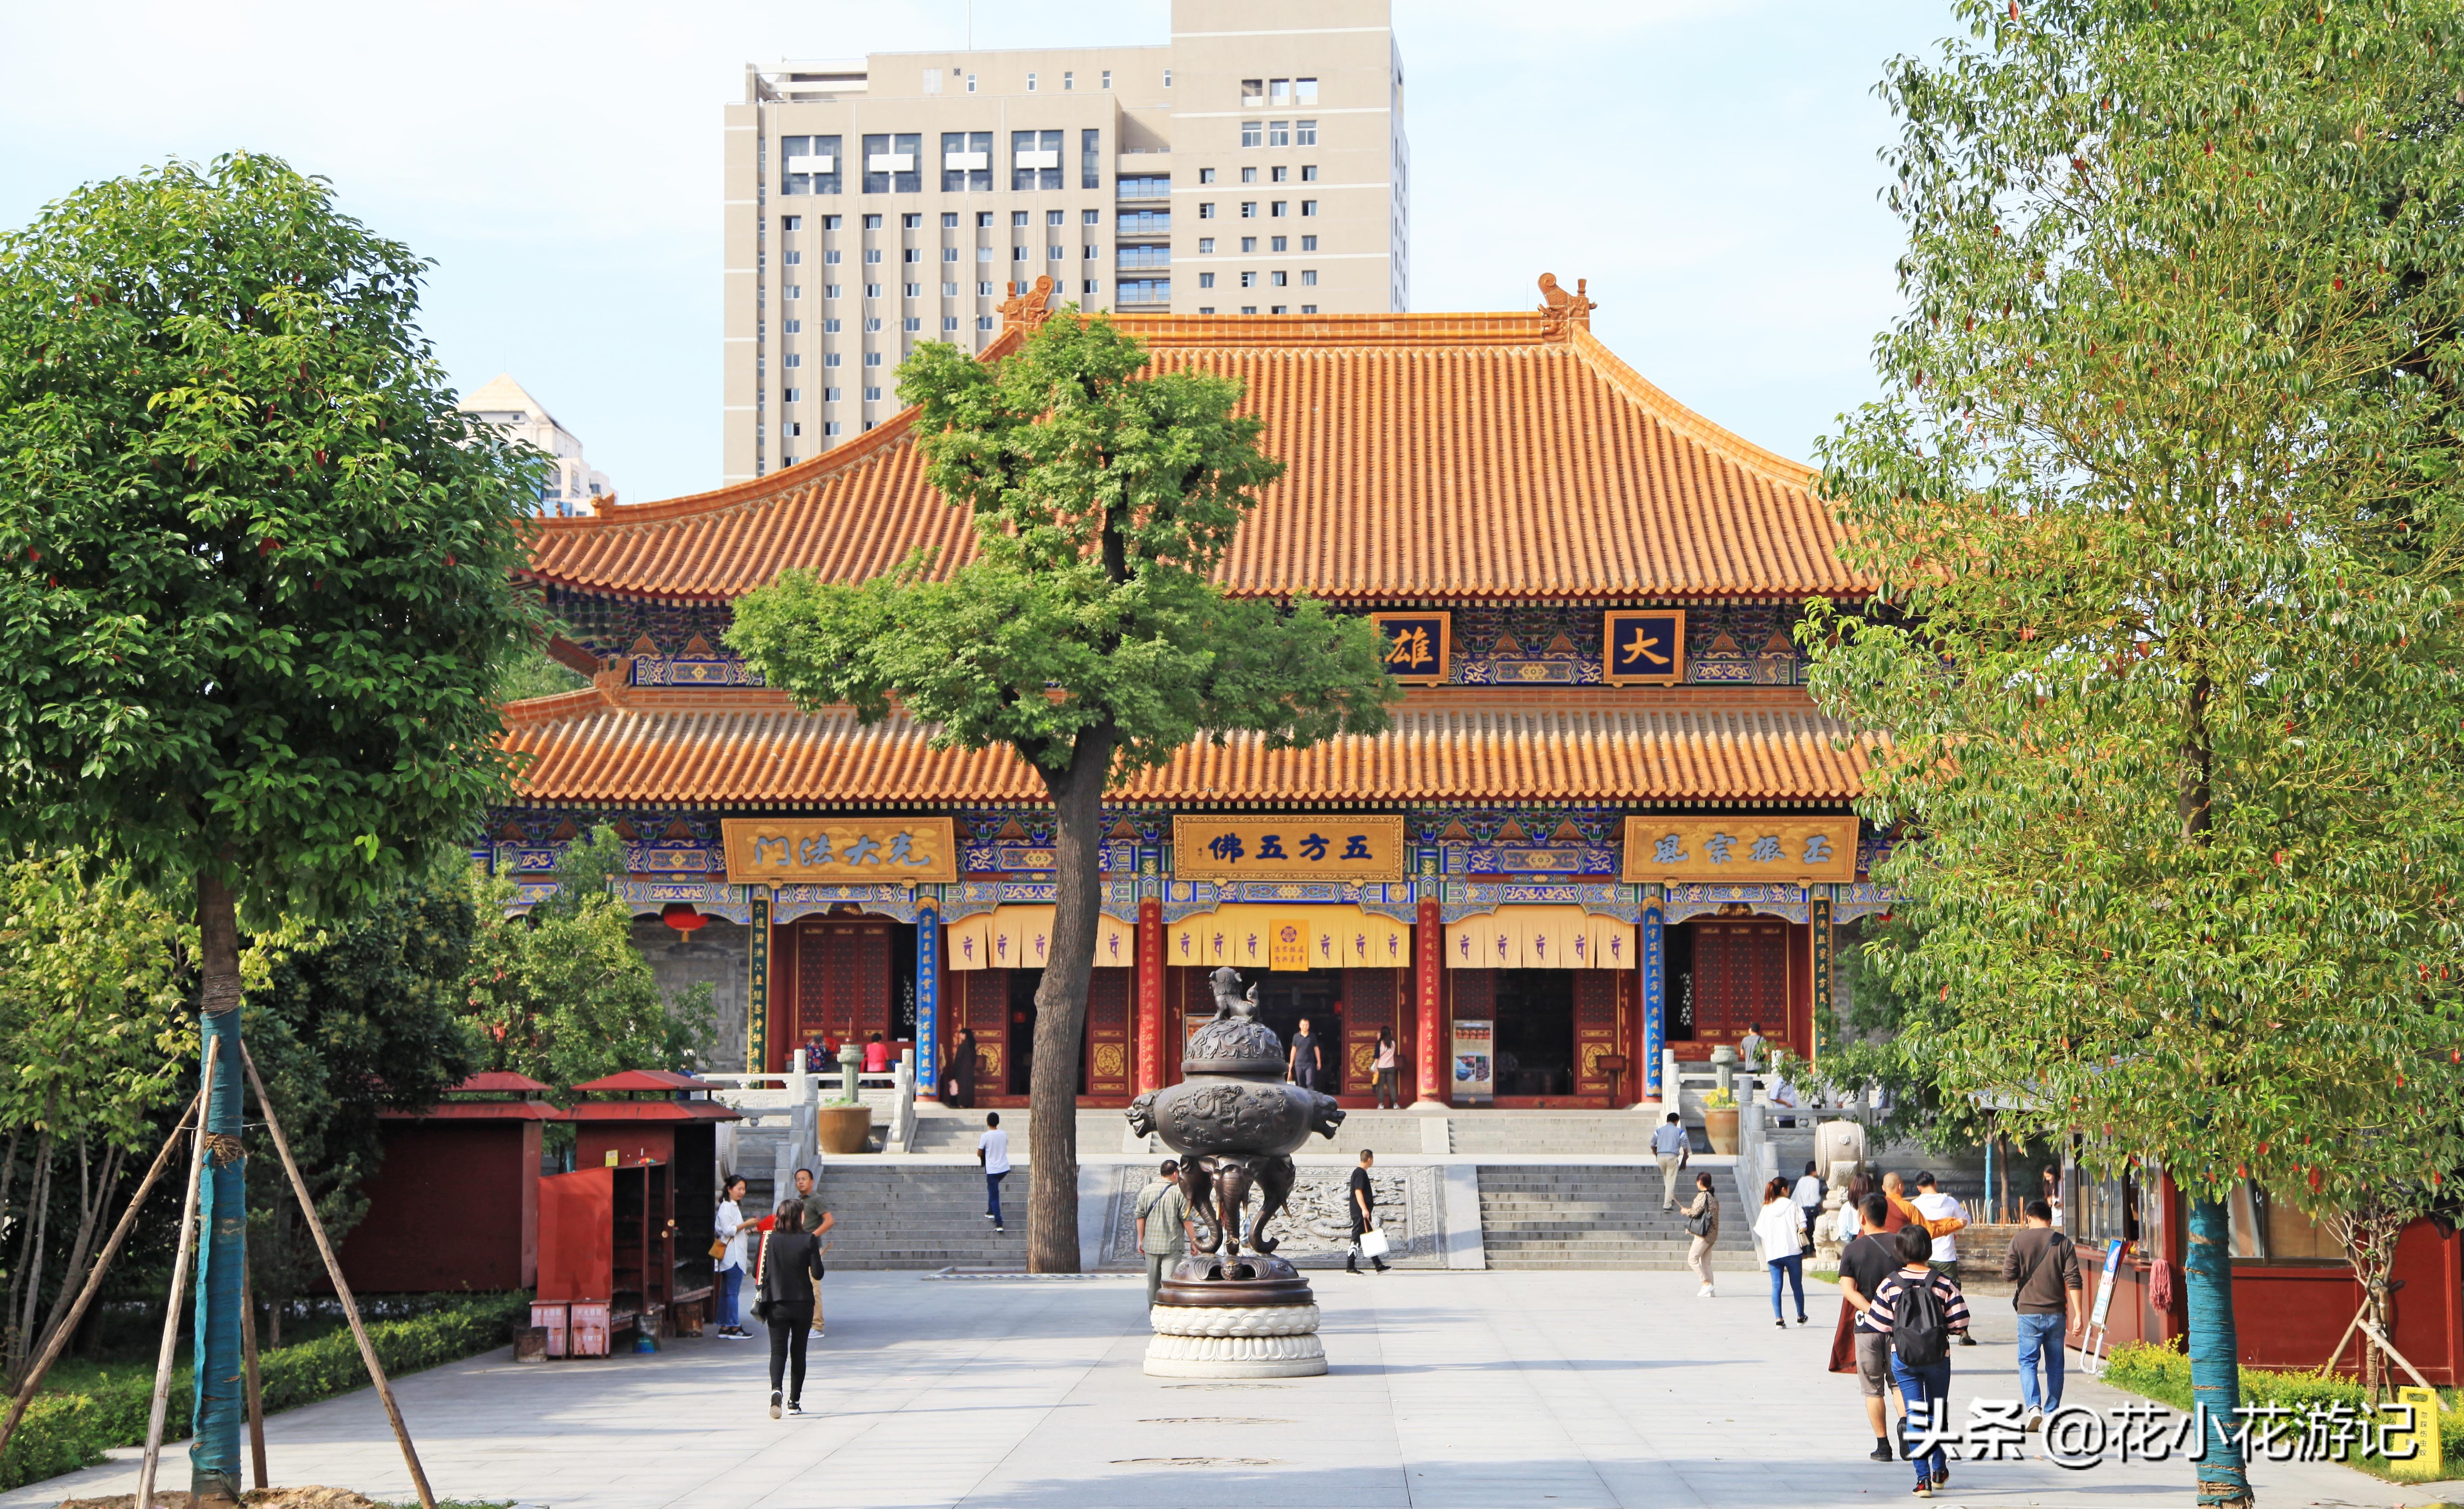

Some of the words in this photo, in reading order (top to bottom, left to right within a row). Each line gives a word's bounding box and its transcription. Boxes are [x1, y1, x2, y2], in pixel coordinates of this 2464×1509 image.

[1384, 626, 1434, 669] 雄
[1622, 627, 1670, 665] 大
[1208, 832, 1373, 864] 五方五佛
[2419, 1412, 2428, 1456] 勿踩伤虫蚁
